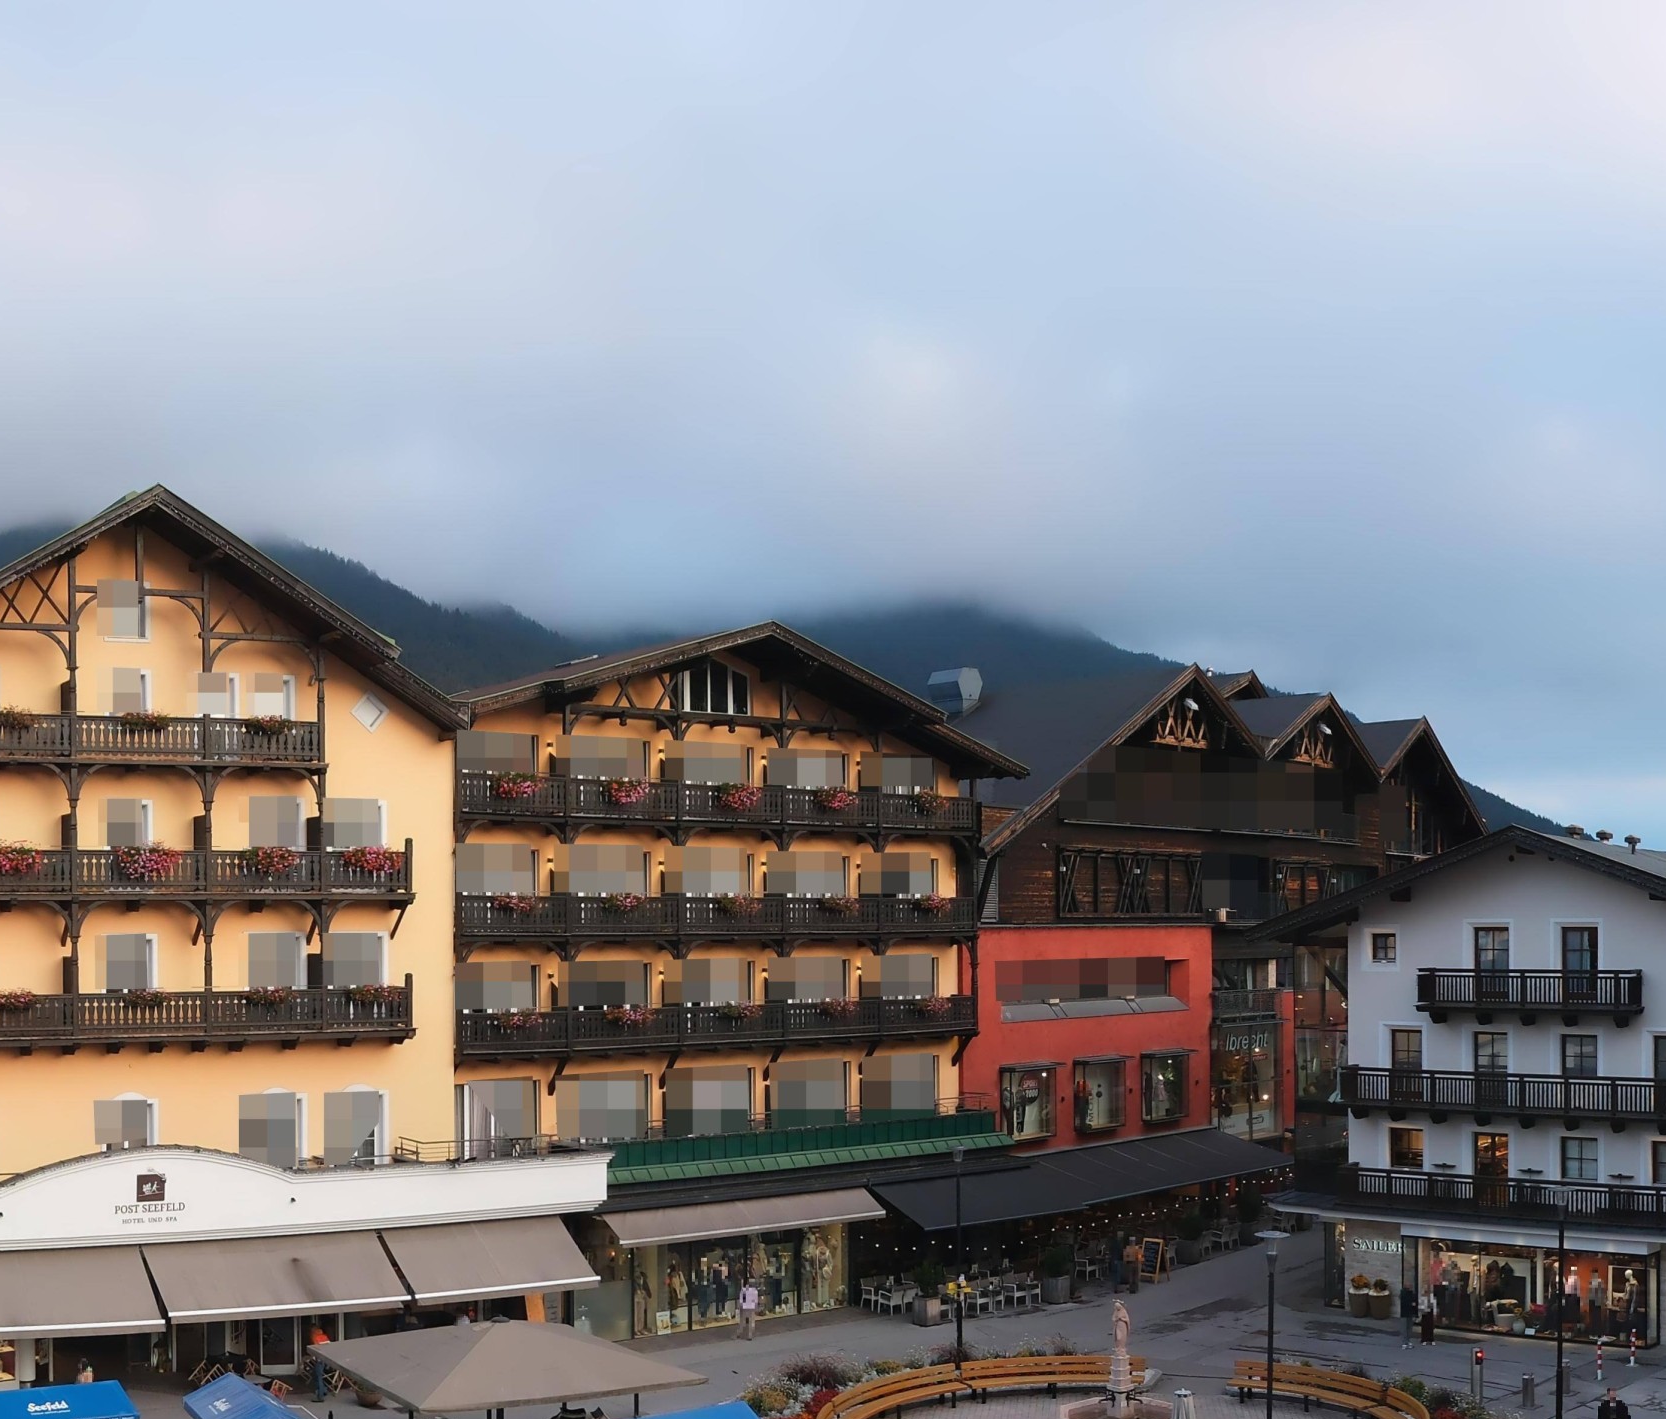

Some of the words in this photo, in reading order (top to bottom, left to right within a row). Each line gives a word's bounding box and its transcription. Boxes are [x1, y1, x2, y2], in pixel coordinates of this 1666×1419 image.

[115, 1203, 141, 1214] POST
[141, 1202, 186, 1214] SEEFELD
[122, 1216, 146, 1225] HOTEL
[148, 1216, 164, 1224] UND
[1352, 1236, 1407, 1254] SAILER
[27, 1399, 70, 1413] Seefeld
